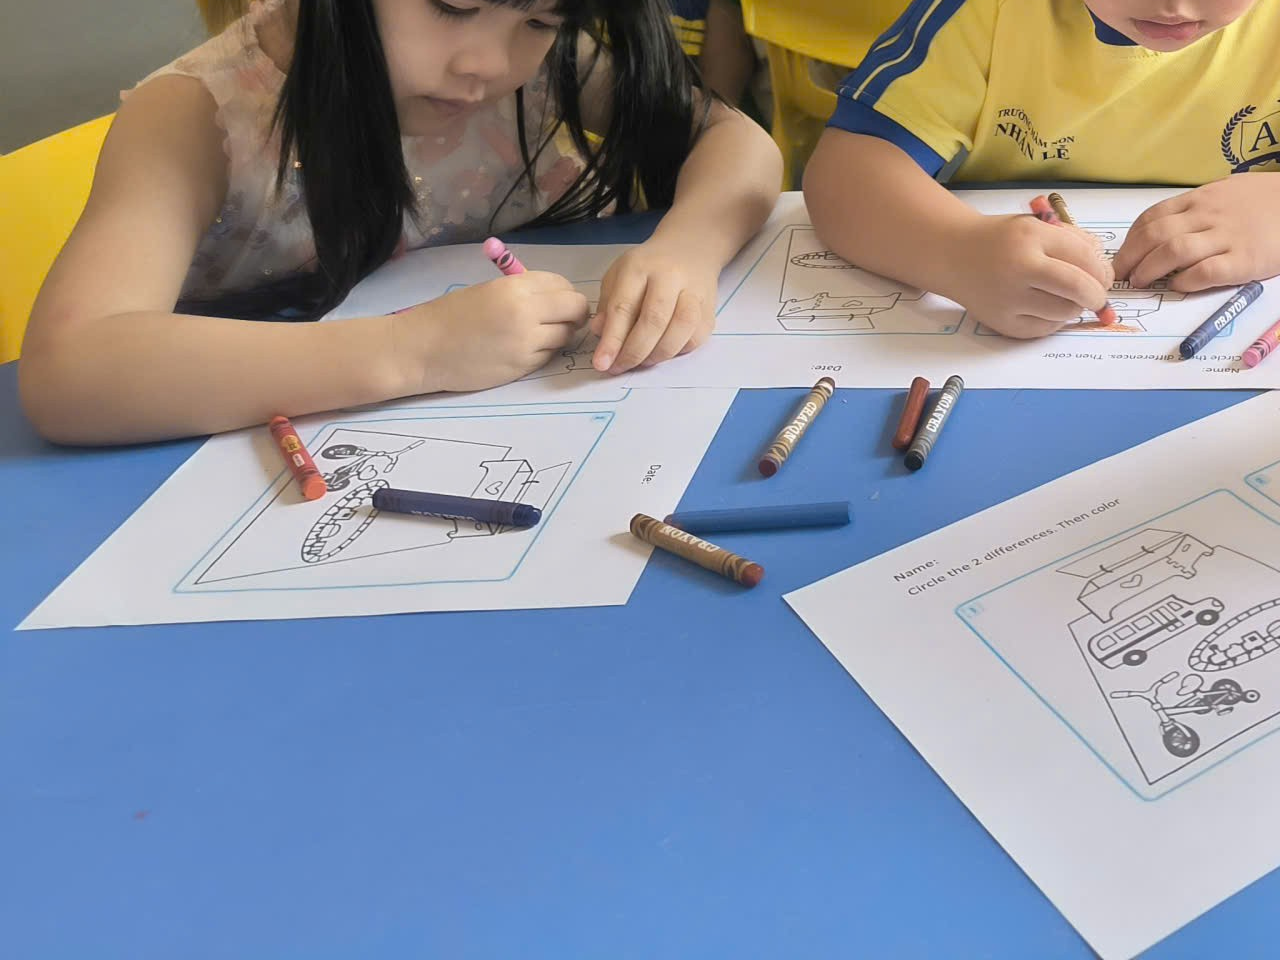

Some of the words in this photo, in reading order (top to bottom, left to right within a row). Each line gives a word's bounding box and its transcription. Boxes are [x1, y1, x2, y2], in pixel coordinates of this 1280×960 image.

[1249, 121, 1279, 153] A
[1213, 294, 1249, 332] CRAYON
[811, 364, 842, 372] Date:
[1073, 352, 1103, 360] Then
[1108, 352, 1175, 361] differences.
[783, 401, 817, 443] CRAYON
[926, 391, 954, 433] CRAYON
[641, 464, 662, 485] Date:
[659, 525, 720, 552] CRAYON
[907, 574, 947, 596] Circle
[947, 561, 971, 577] the
[971, 557, 983, 567] 2
[983, 527, 1059, 561] differences.
[1055, 513, 1090, 530] Then
[1091, 496, 1121, 515] color
[893, 558, 940, 582] Name:
